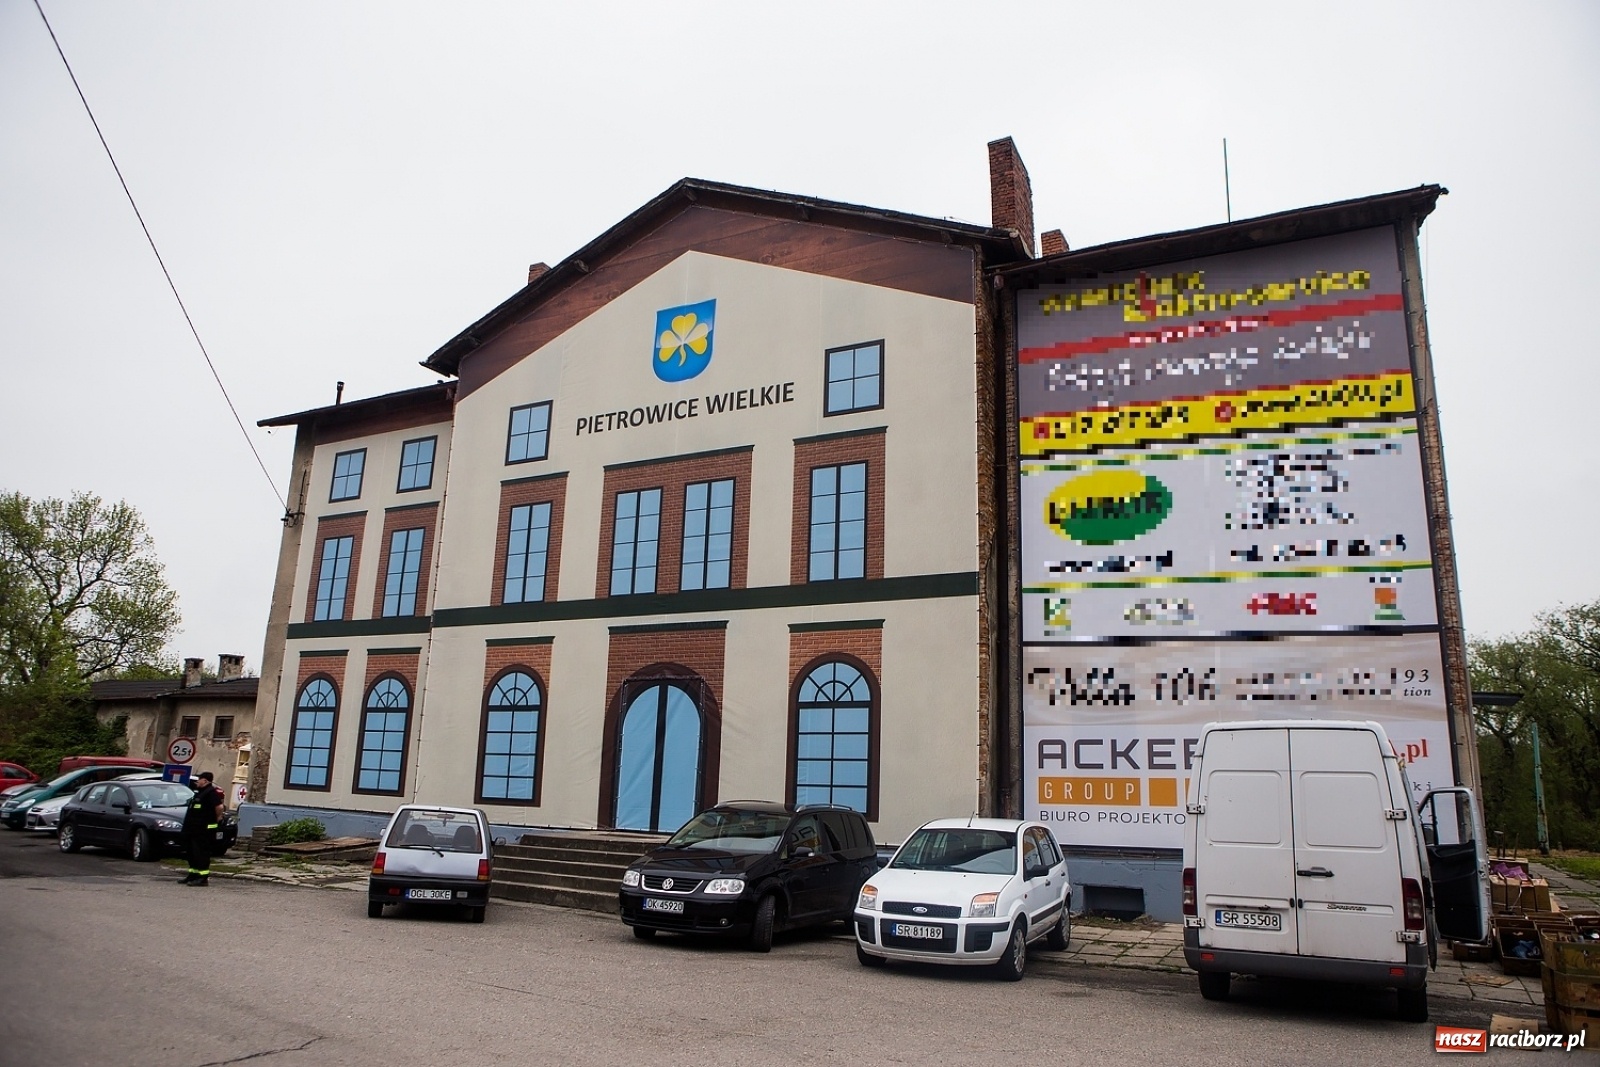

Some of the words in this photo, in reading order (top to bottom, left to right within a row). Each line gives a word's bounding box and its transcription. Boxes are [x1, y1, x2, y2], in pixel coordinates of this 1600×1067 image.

[576, 398, 700, 436] PIETROWICE
[705, 382, 795, 415] WIELKIE
[1044, 781, 1135, 801] GROUP
[1040, 810, 1091, 823] BIURO
[410, 889, 428, 898] OGL
[647, 899, 658, 909] OK
[659, 900, 684, 911] 45920
[1222, 911, 1240, 924] SR
[1243, 913, 1279, 927] 55508
[897, 924, 911, 936] SR
[912, 926, 942, 938] 81189
